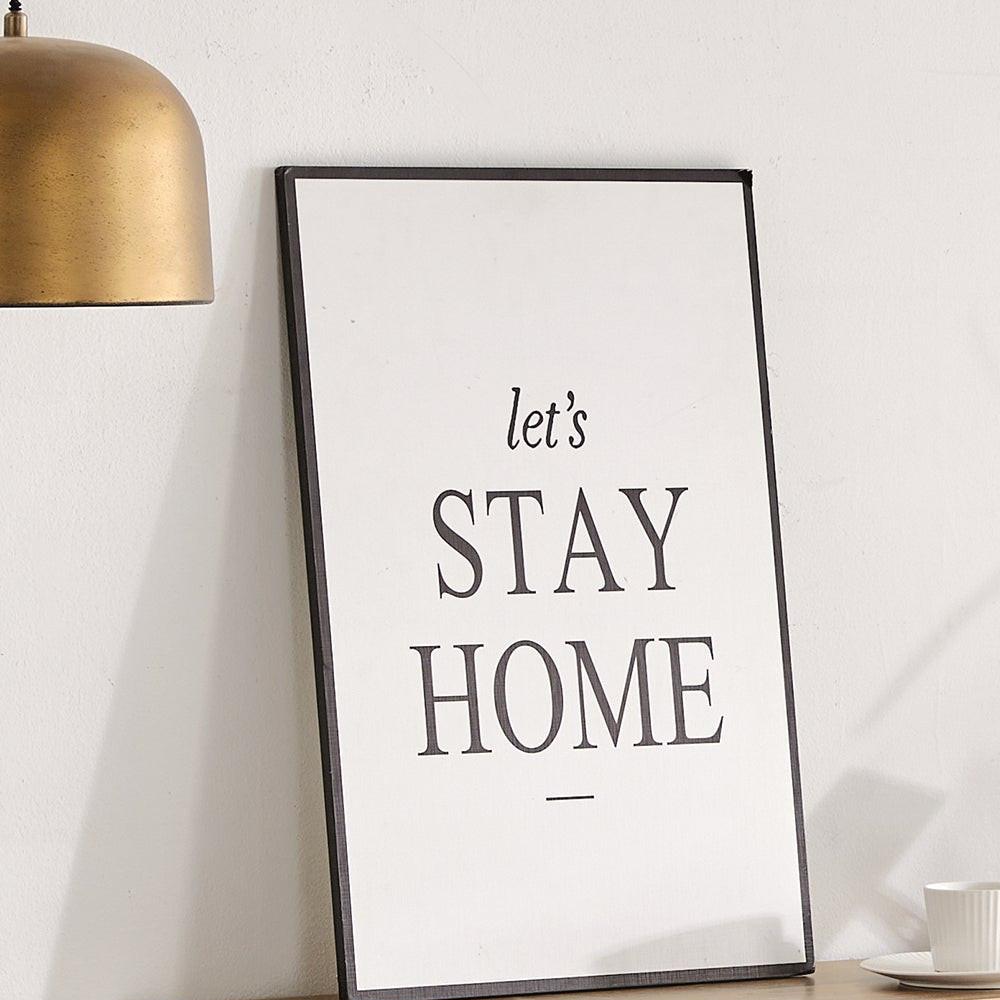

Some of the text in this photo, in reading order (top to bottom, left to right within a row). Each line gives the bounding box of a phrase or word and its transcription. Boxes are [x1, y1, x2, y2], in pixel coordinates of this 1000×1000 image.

[507, 386, 588, 450] let's
[432, 486, 689, 599] STAY
[409, 636, 724, 756] HOME
